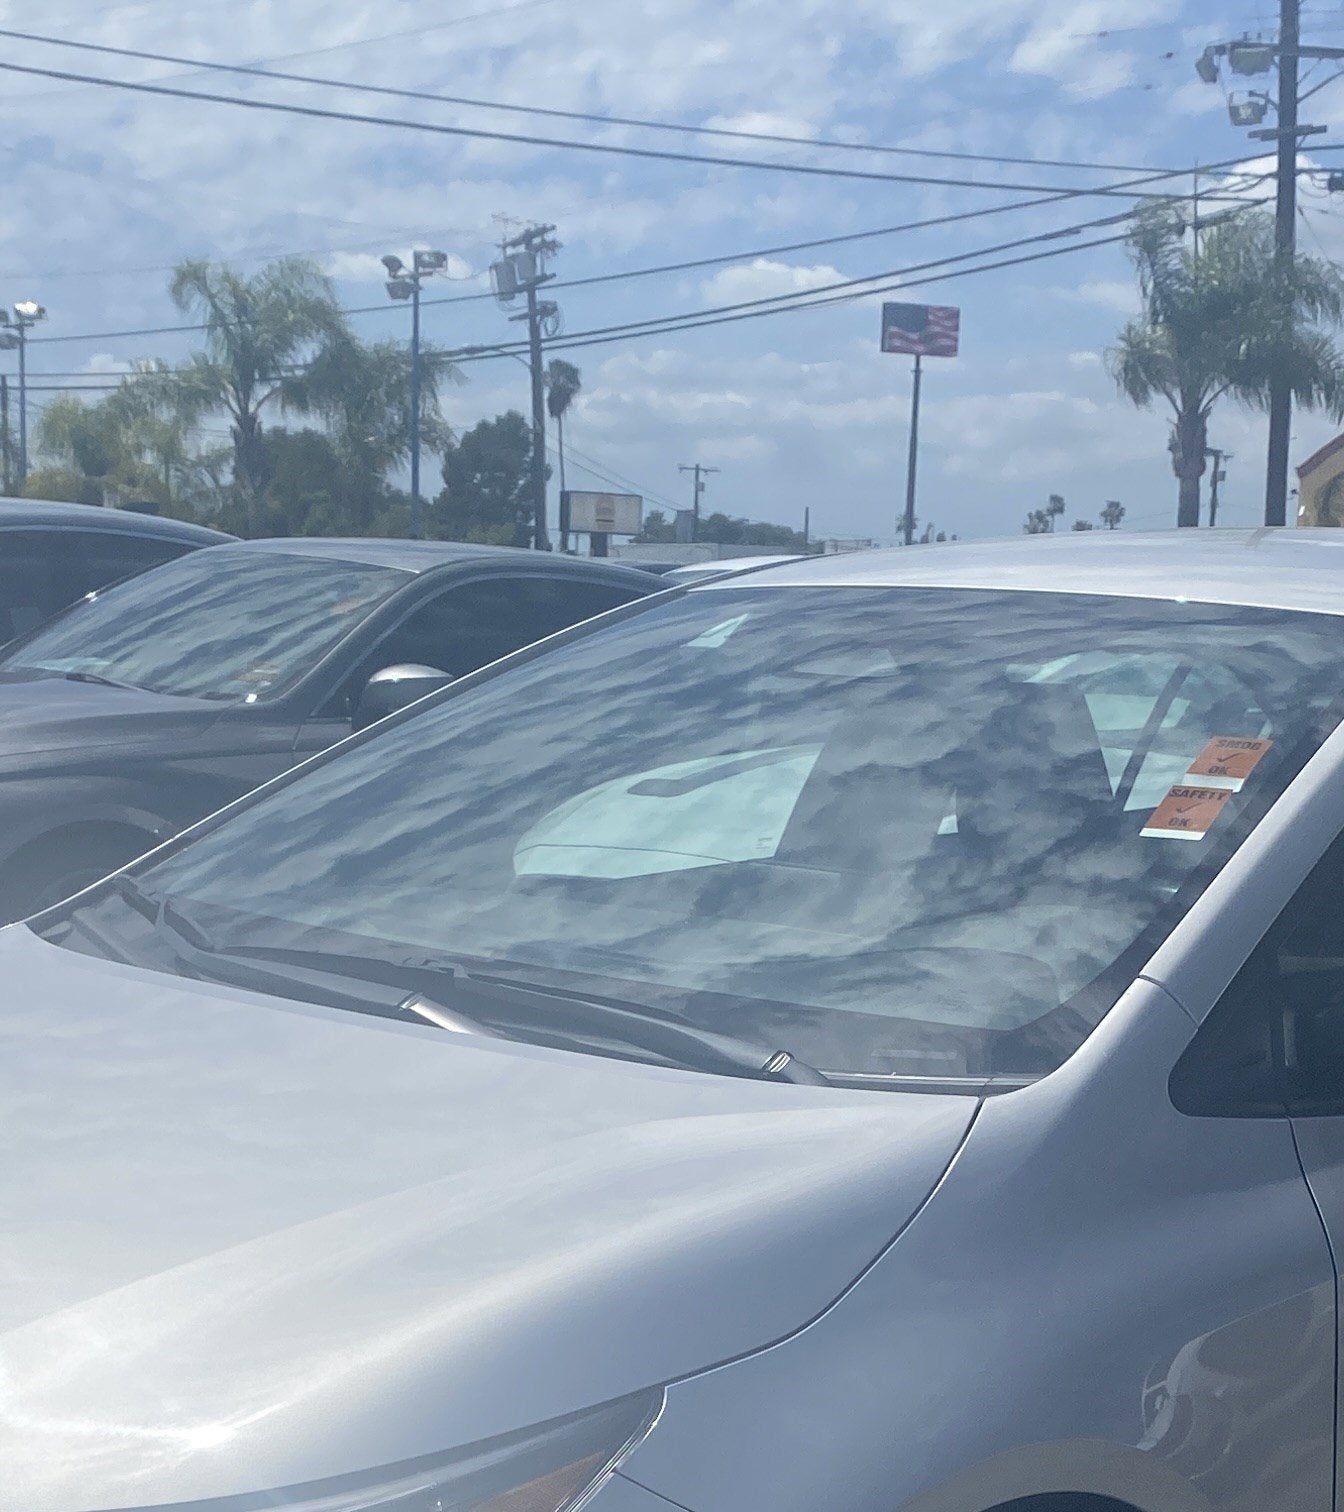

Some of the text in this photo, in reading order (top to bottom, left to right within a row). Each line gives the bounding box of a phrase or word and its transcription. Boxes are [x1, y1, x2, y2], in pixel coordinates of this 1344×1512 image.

[1208, 765, 1230, 775] OK
[1169, 788, 1228, 801] SAFETY
[1167, 817, 1191, 827] OK
